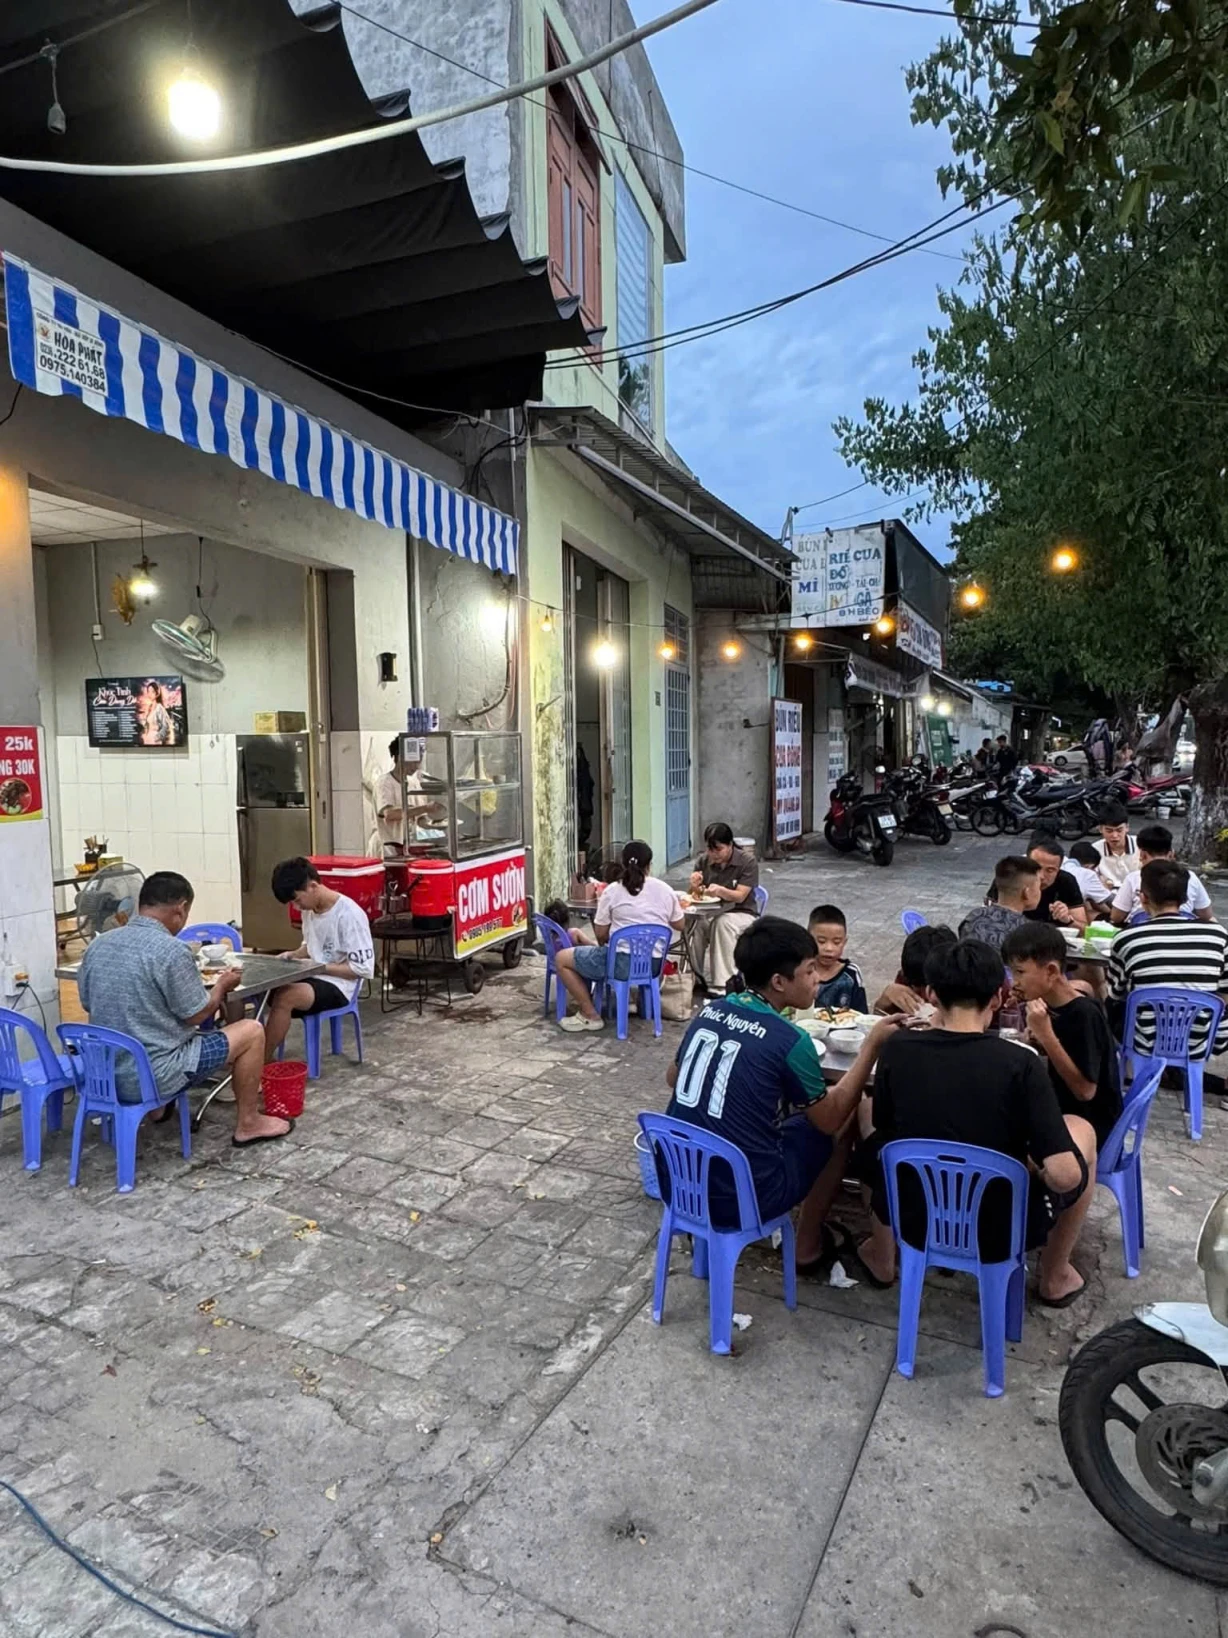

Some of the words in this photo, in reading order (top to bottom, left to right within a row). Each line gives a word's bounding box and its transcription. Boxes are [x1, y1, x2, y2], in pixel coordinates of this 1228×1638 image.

[78, 341, 103, 366] PHÁT
[39, 355, 106, 392] 0975.140384
[853, 547, 881, 561] CUA
[15, 759, 36, 775] 30K
[458, 877, 490, 923] CƠM
[492, 861, 525, 911] SƯỜN
[700, 1005, 725, 1022] Phúc
[676, 1028, 742, 1119] 01
